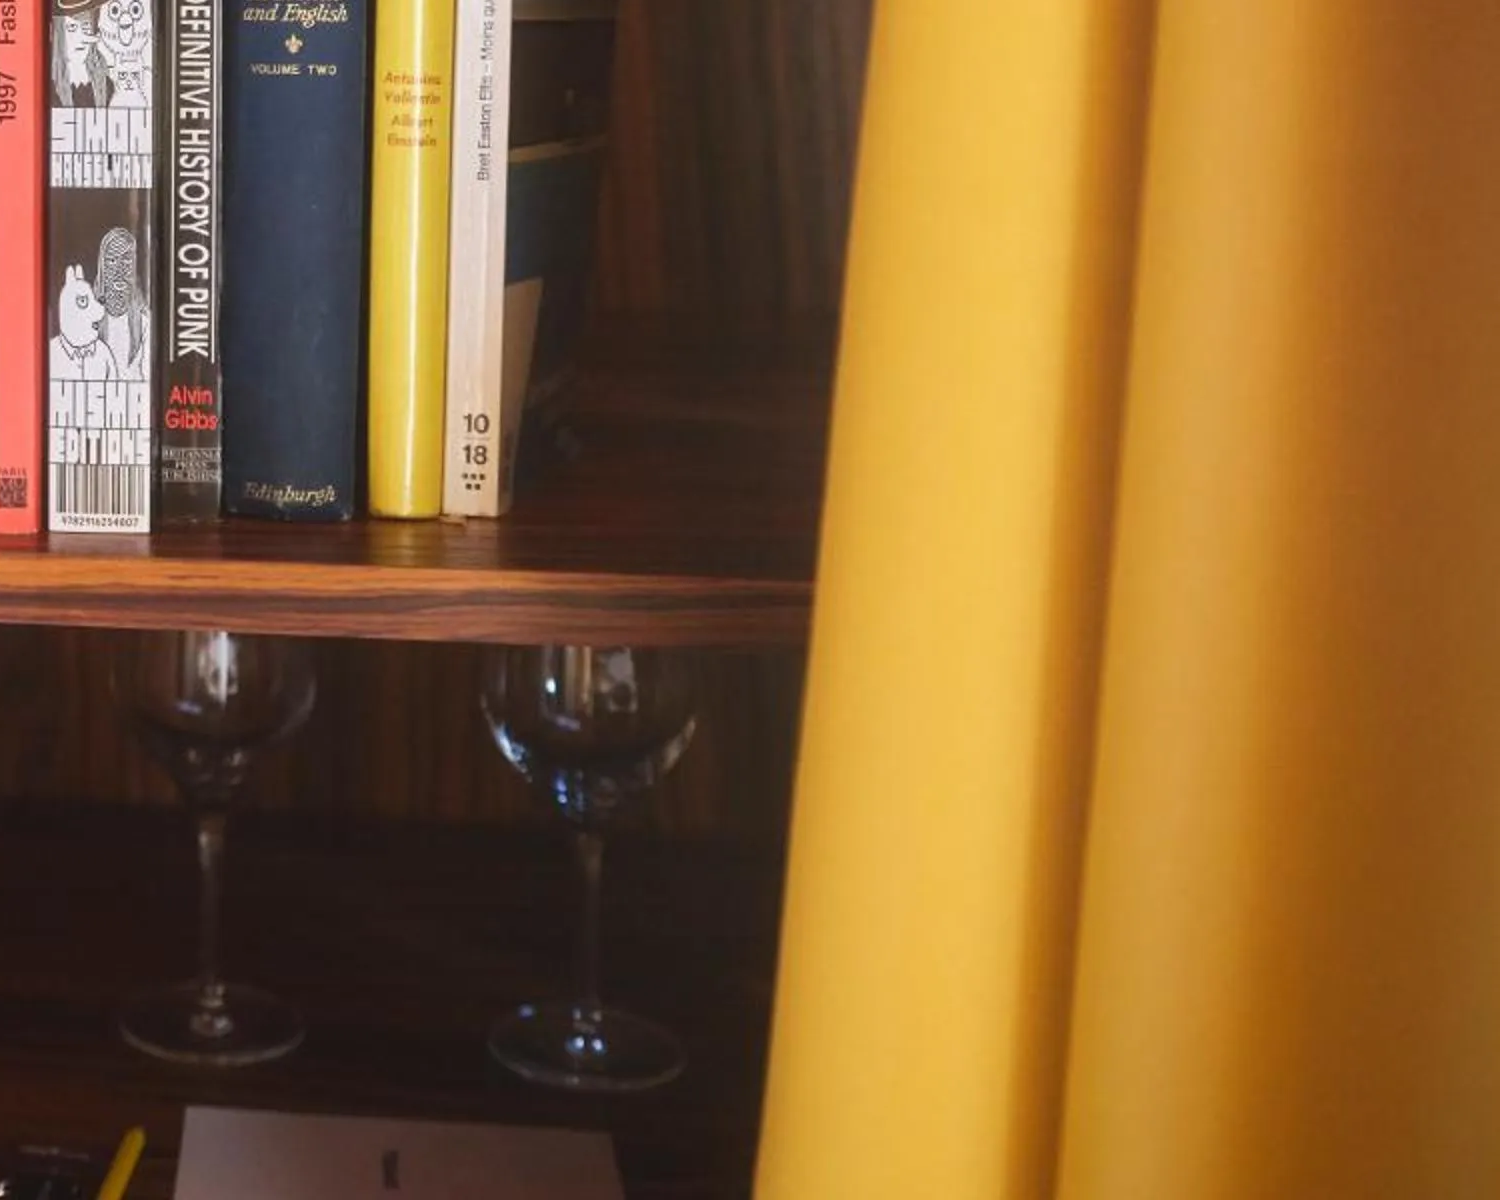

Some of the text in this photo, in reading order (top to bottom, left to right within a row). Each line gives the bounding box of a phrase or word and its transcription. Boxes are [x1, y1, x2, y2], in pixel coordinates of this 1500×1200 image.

[244, 3, 349, 28] and English
[480, 21, 494, 61] Moins
[251, 64, 338, 75] VOLUME TWO
[51, 108, 152, 153] SIMON
[477, 104, 491, 150] Easton
[179, 131, 210, 235] HISTORY
[477, 154, 489, 182] Bret
[178, 240, 210, 279] OF
[178, 287, 209, 357] PUNK
[50, 382, 150, 427] MISMA
[170, 386, 212, 404] Alvin
[166, 408, 218, 430] Gibbs
[462, 414, 490, 436] 10
[50, 428, 150, 464] EDITIONS
[462, 444, 488, 466] 18
[245, 482, 338, 505] Edinburgh
